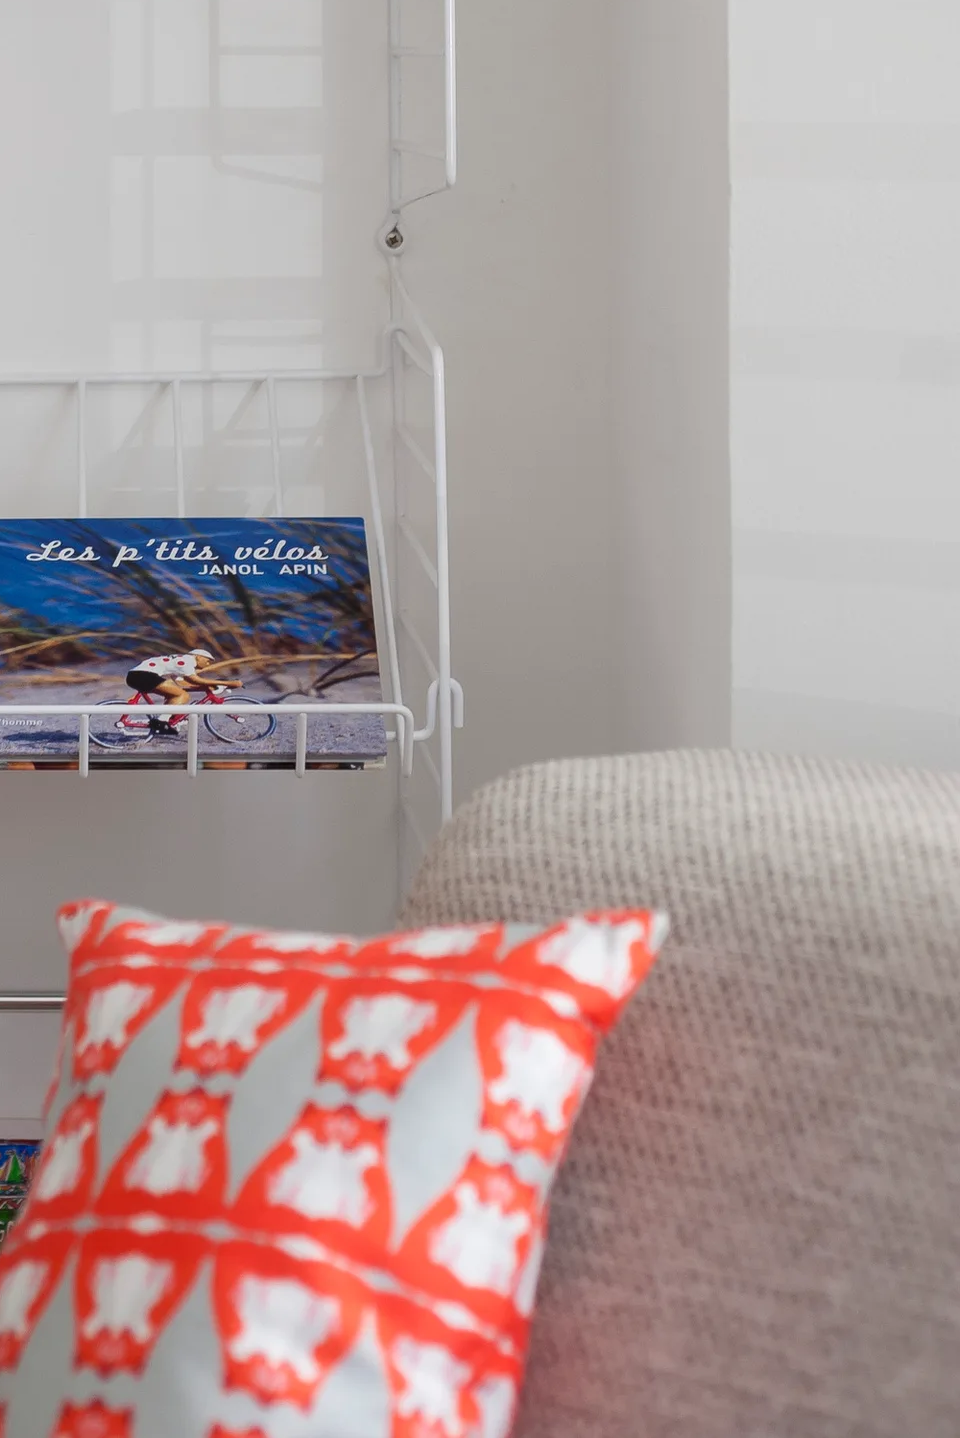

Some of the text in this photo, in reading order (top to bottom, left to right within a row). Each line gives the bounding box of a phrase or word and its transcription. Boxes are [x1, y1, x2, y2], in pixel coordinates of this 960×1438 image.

[26, 538, 329, 568] Les p'tits vélos
[198, 564, 328, 576] JANOL APIN
